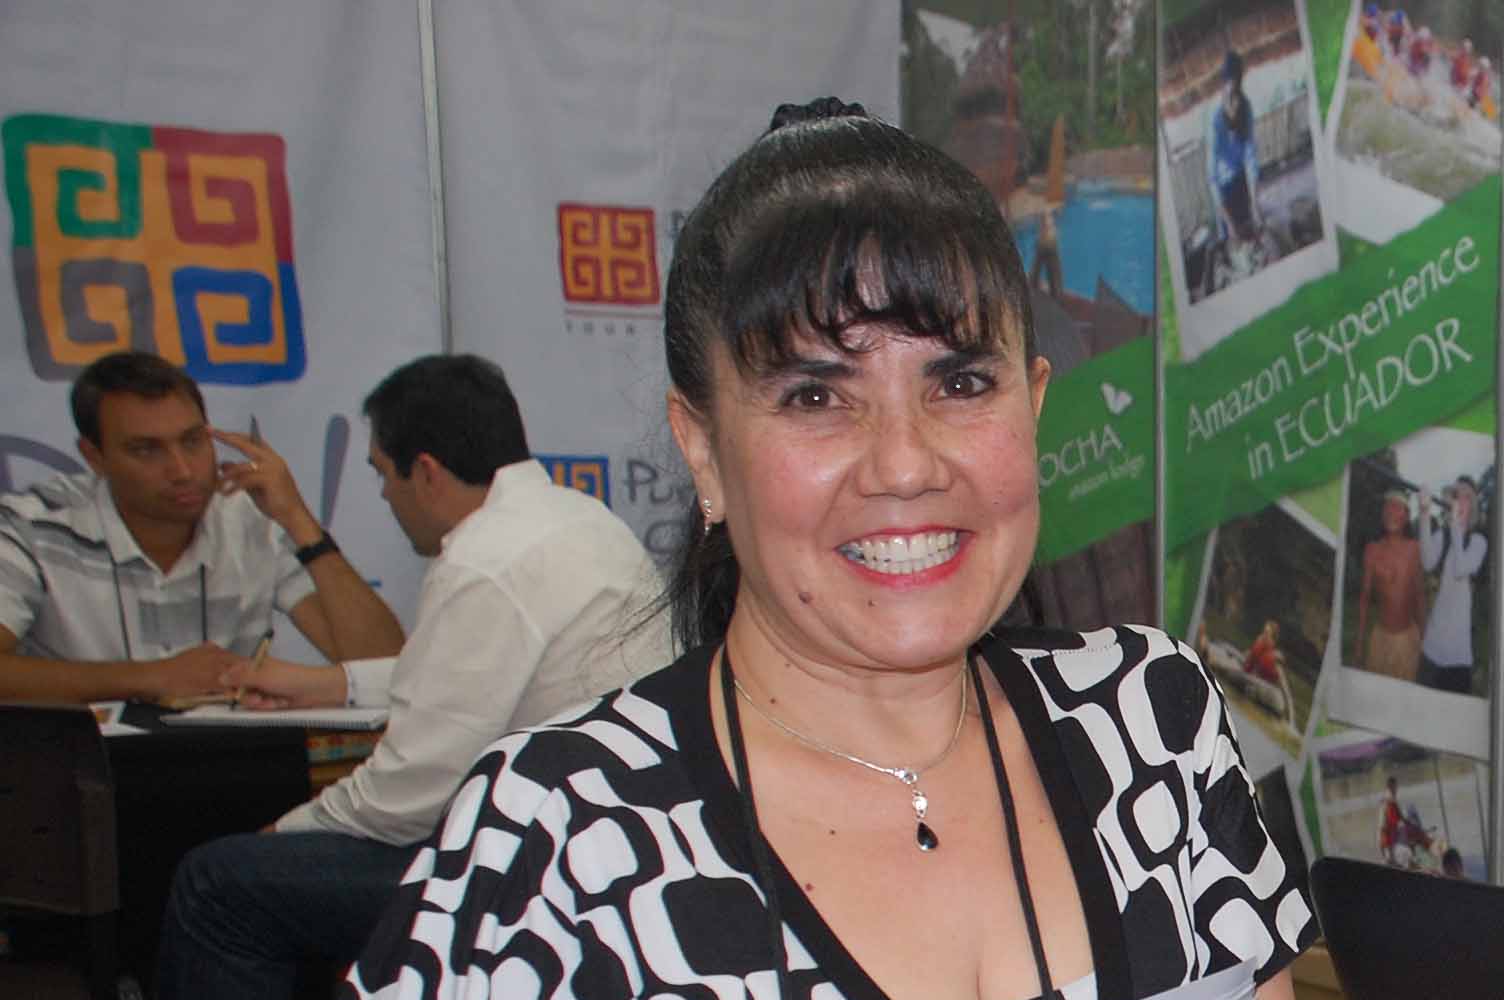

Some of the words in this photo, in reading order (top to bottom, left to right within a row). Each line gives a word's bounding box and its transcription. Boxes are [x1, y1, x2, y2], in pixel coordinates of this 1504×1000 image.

[1186, 356, 1293, 453] Amazon
[1293, 235, 1480, 379] Experience
[1248, 434, 1274, 480] in
[1274, 318, 1473, 463] ECUADOR
[1039, 423, 1123, 487] OCHA
